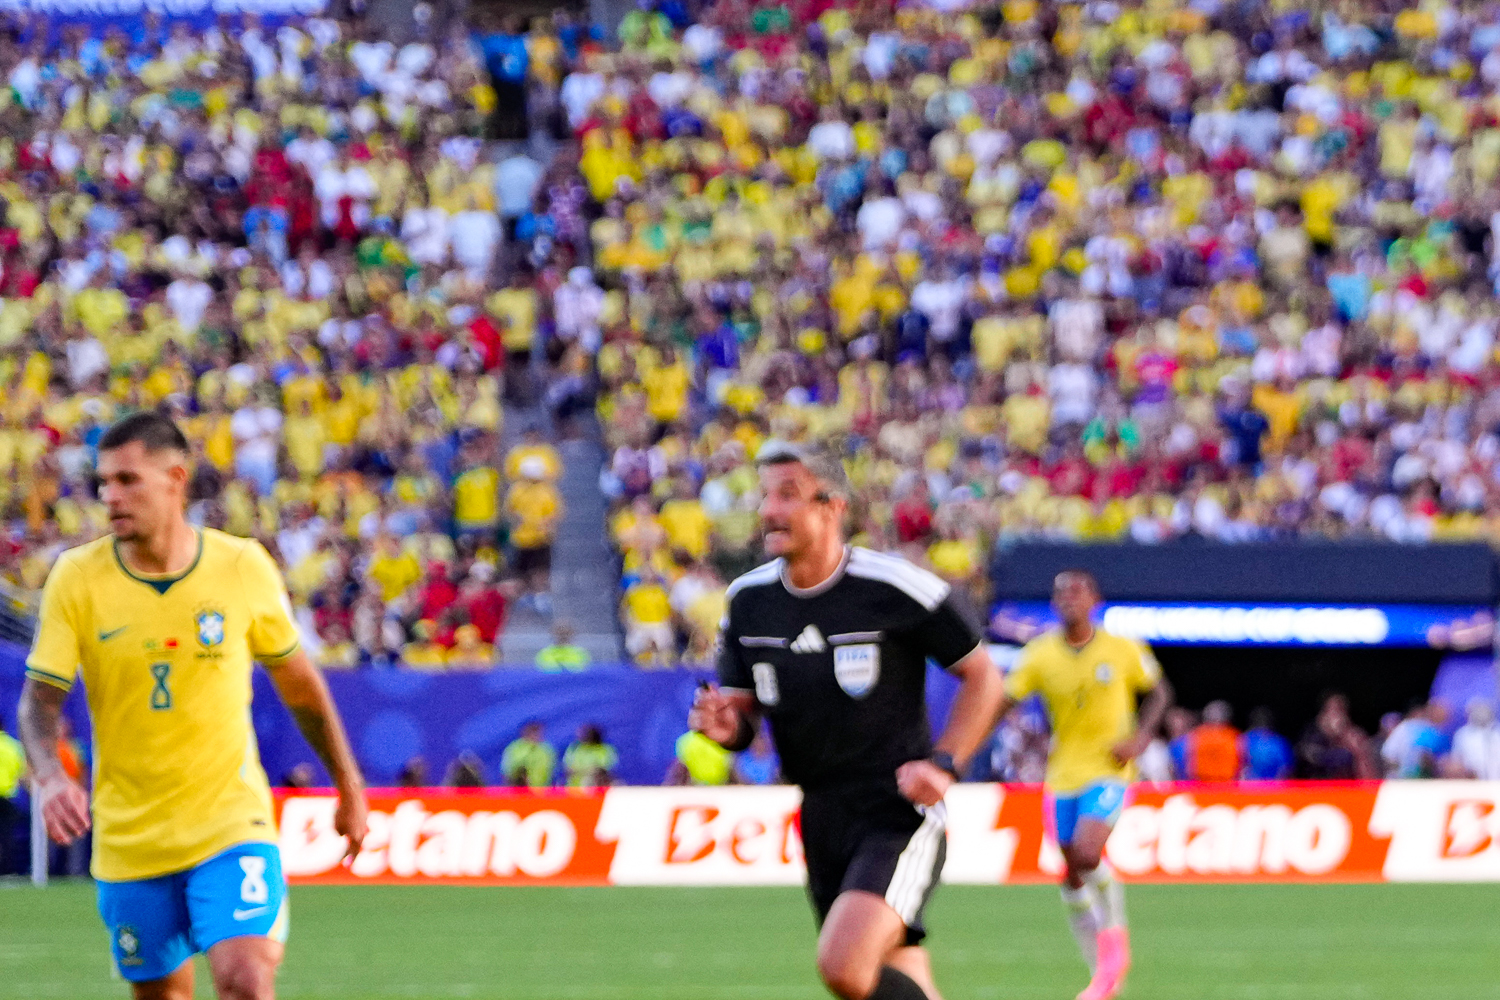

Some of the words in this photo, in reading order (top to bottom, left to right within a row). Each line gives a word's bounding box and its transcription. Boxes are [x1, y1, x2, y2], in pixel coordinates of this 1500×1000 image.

[150, 662, 172, 710] 8
[279, 797, 577, 878] Betano
[663, 804, 803, 866] Bet
[1039, 794, 1351, 876] etano
[239, 856, 269, 904] 8
